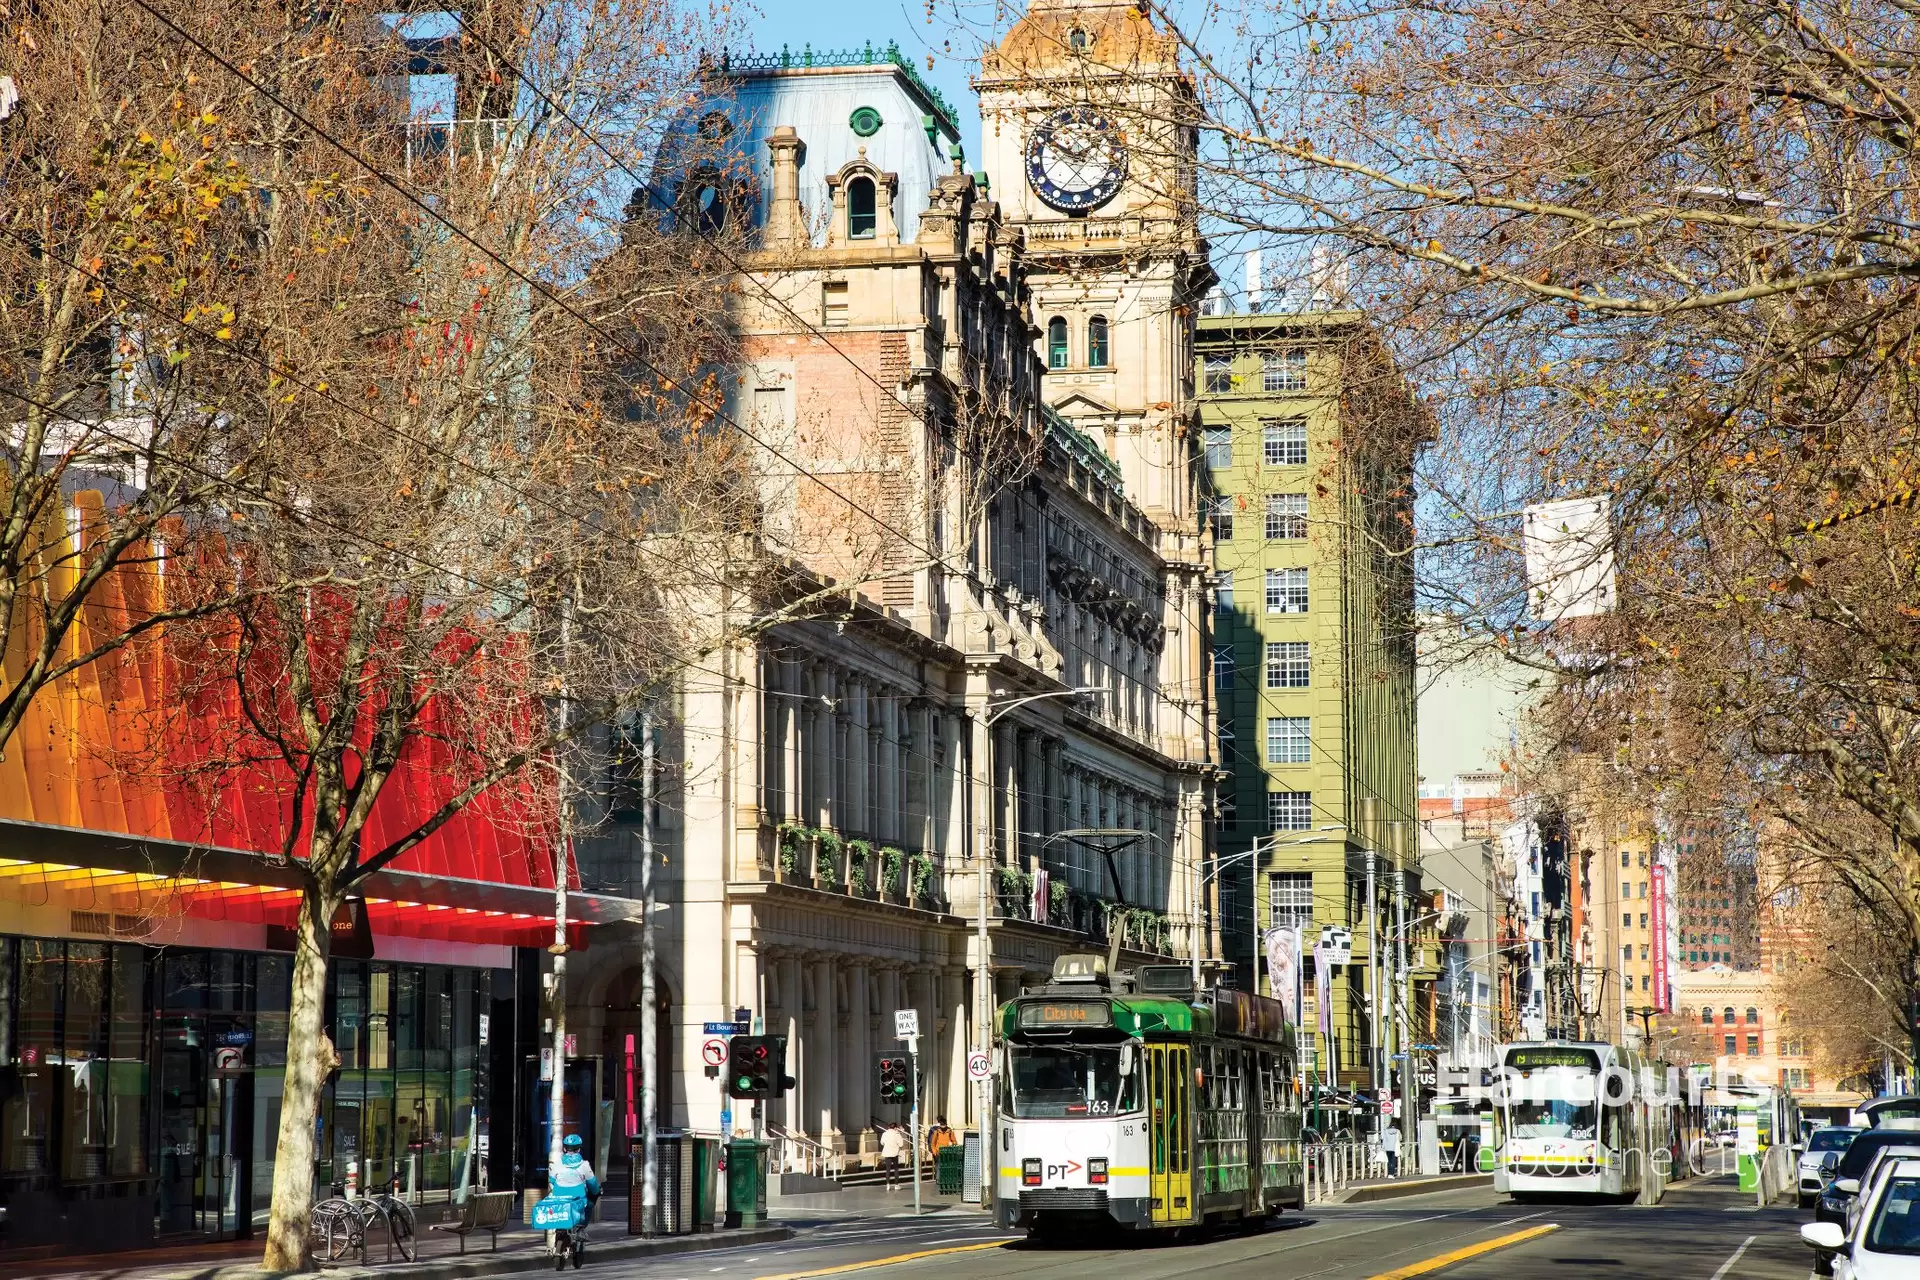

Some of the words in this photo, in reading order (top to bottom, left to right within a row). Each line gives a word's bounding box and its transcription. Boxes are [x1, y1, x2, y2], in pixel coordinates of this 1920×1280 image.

[899, 1012, 914, 1020] ONE
[1043, 1007, 1067, 1021] City
[1069, 1008, 1086, 1020] via
[708, 1023, 716, 1031] Lt
[716, 1023, 738, 1031] Bourke
[971, 1060, 988, 1071] 40
[1086, 1101, 1109, 1113] 163
[1123, 1125, 1134, 1137] 163
[1571, 1129, 1592, 1139] 5004
